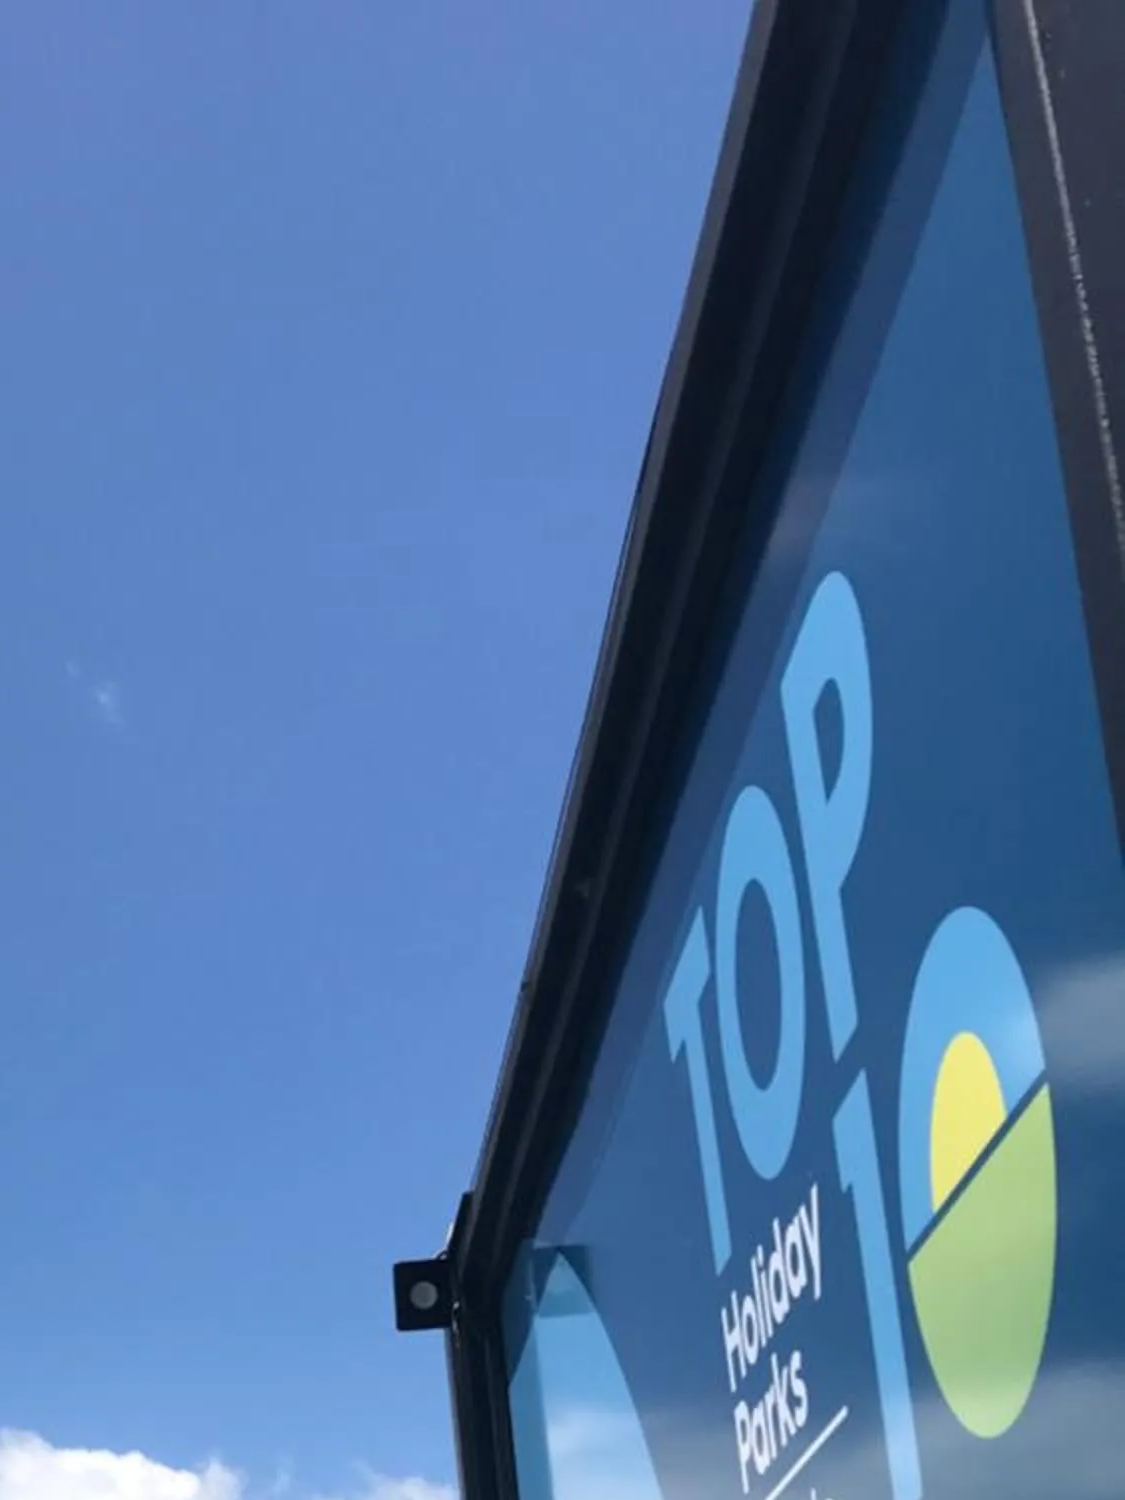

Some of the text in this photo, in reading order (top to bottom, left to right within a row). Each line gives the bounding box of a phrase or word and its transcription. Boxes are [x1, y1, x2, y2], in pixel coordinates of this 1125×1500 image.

[664, 571, 872, 1276] TOP
[721, 1183, 821, 1392] Holiday
[734, 1351, 808, 1494] Parks
